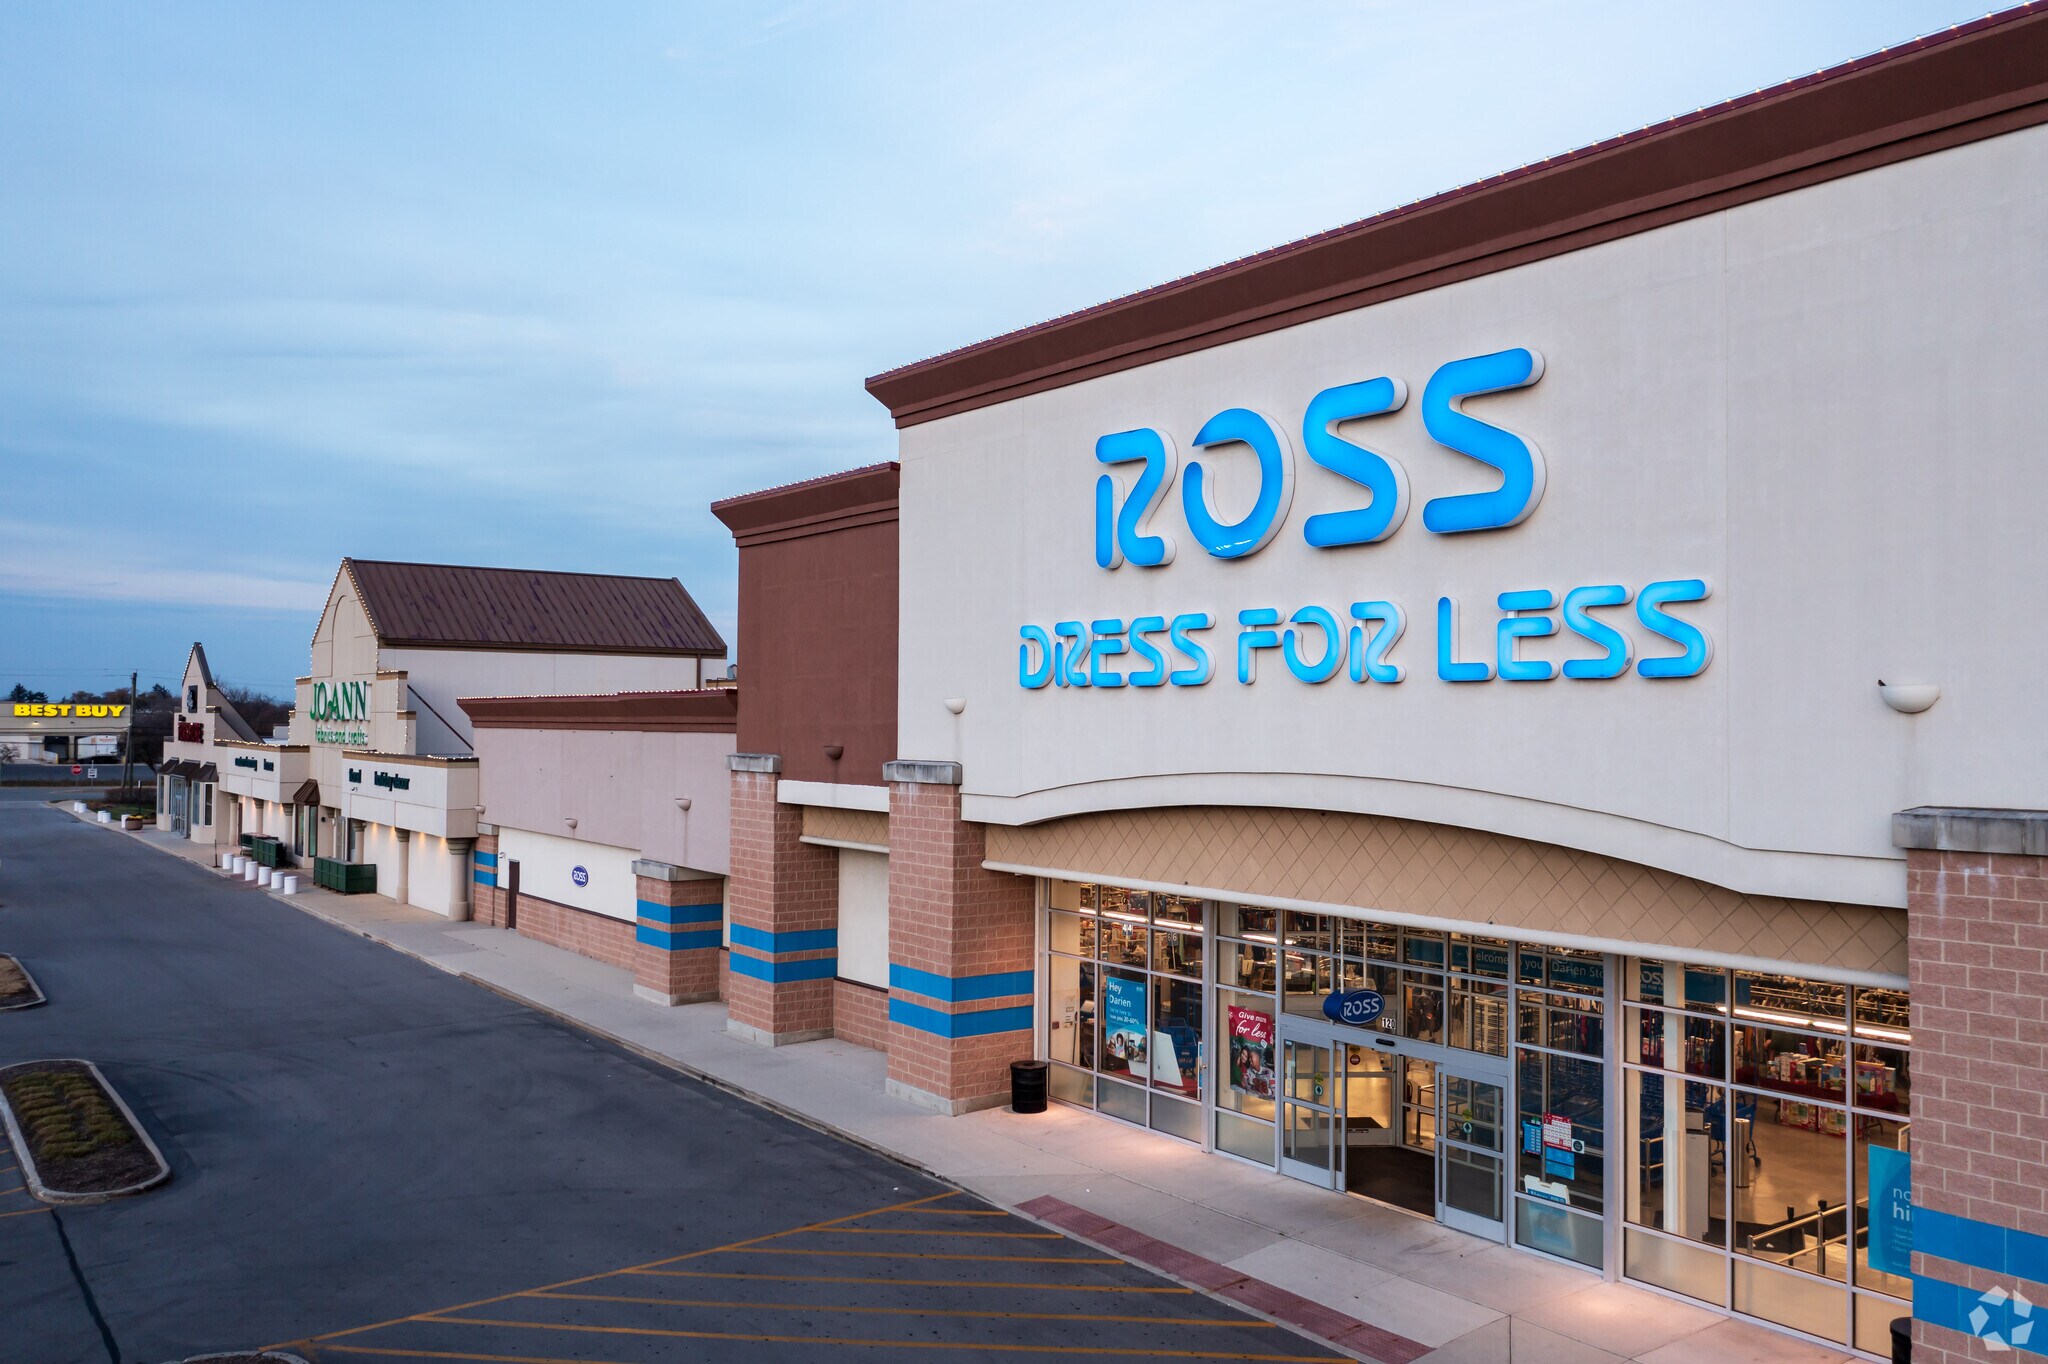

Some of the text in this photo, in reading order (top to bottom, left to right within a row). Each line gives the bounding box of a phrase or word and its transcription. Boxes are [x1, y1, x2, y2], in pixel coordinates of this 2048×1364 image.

[1096, 347, 1546, 569] ROSS
[1020, 579, 1714, 688] DRESS FOR LESS
[14, 704, 125, 717] BEST BUY
[1552, 961, 1587, 976] Darien
[1109, 981, 1122, 994] Hey
[1109, 994, 1131, 1008] Darien
[1343, 997, 1379, 1017] ROSS
[1238, 1011, 1254, 1021] Give
[1236, 1020, 1267, 1039] for less
[1382, 1018, 1396, 1029] 120
